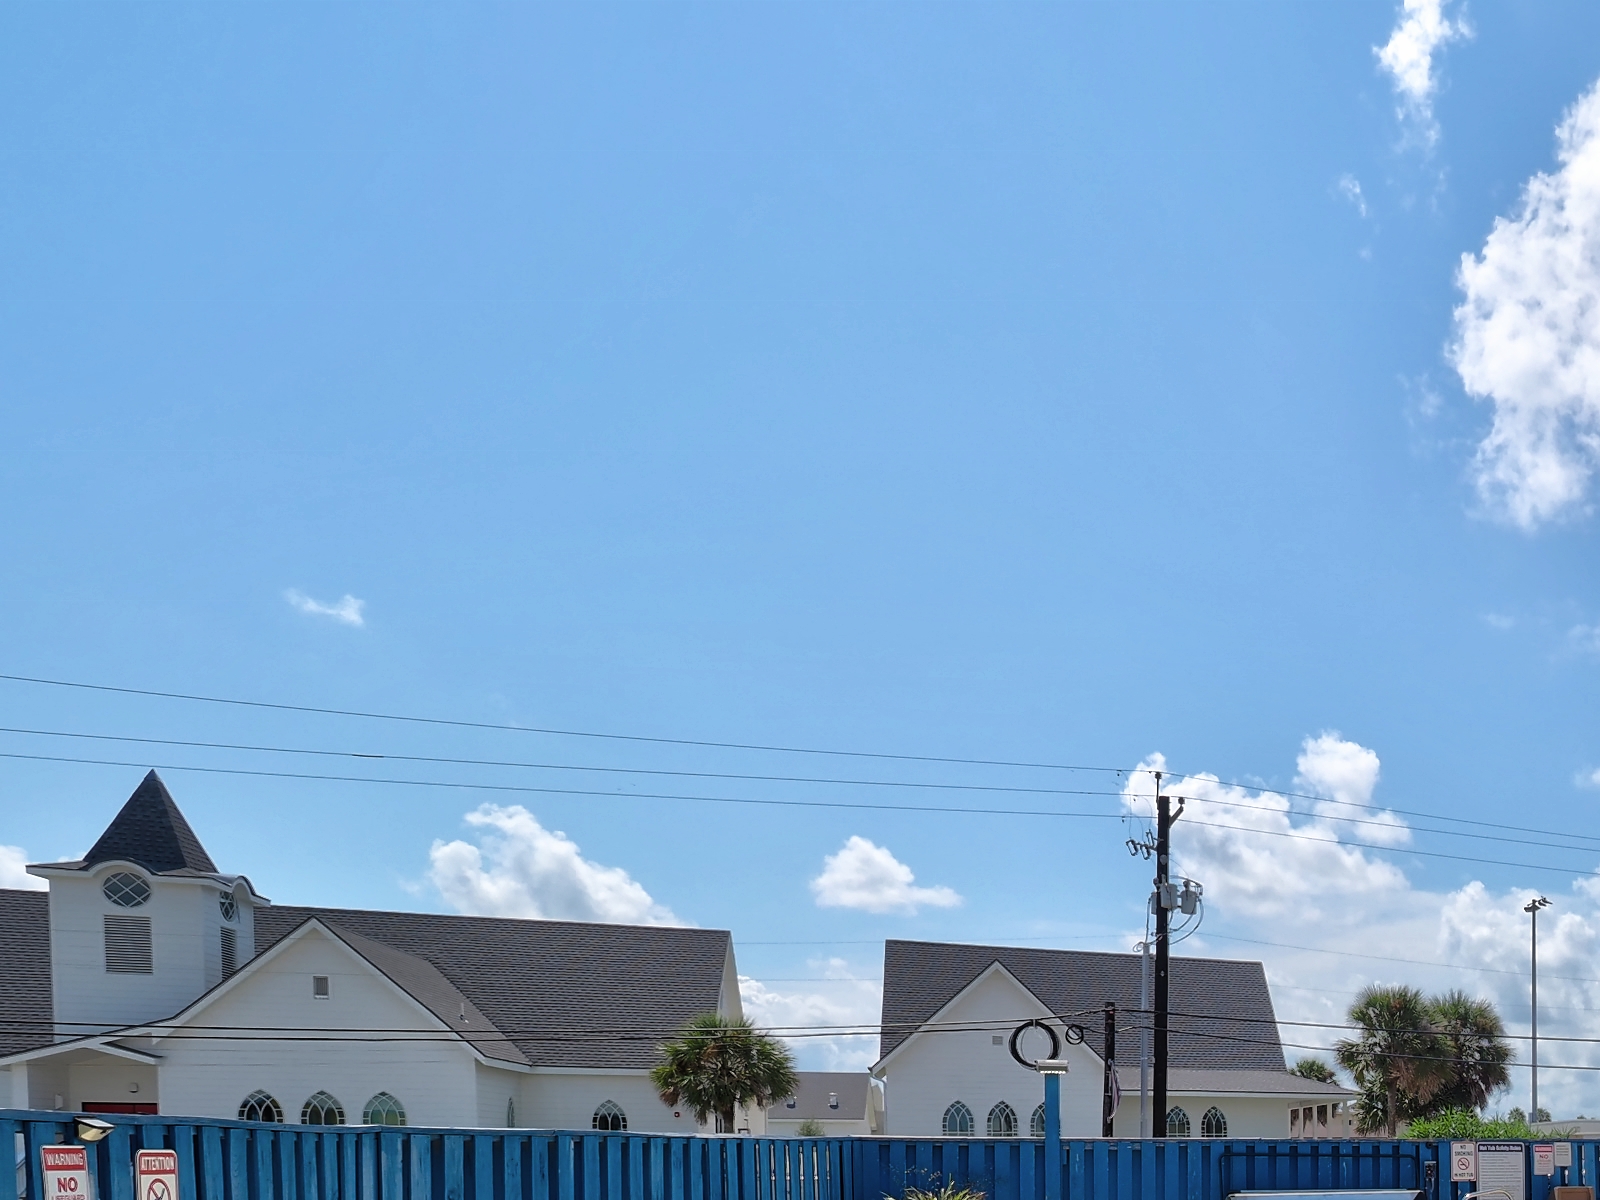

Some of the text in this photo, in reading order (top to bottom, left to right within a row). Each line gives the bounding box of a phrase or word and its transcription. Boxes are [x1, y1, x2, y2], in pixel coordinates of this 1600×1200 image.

[46, 1153, 83, 1166] WARNING
[141, 1156, 175, 1171] ATTENTION
[57, 1177, 78, 1193] NO
